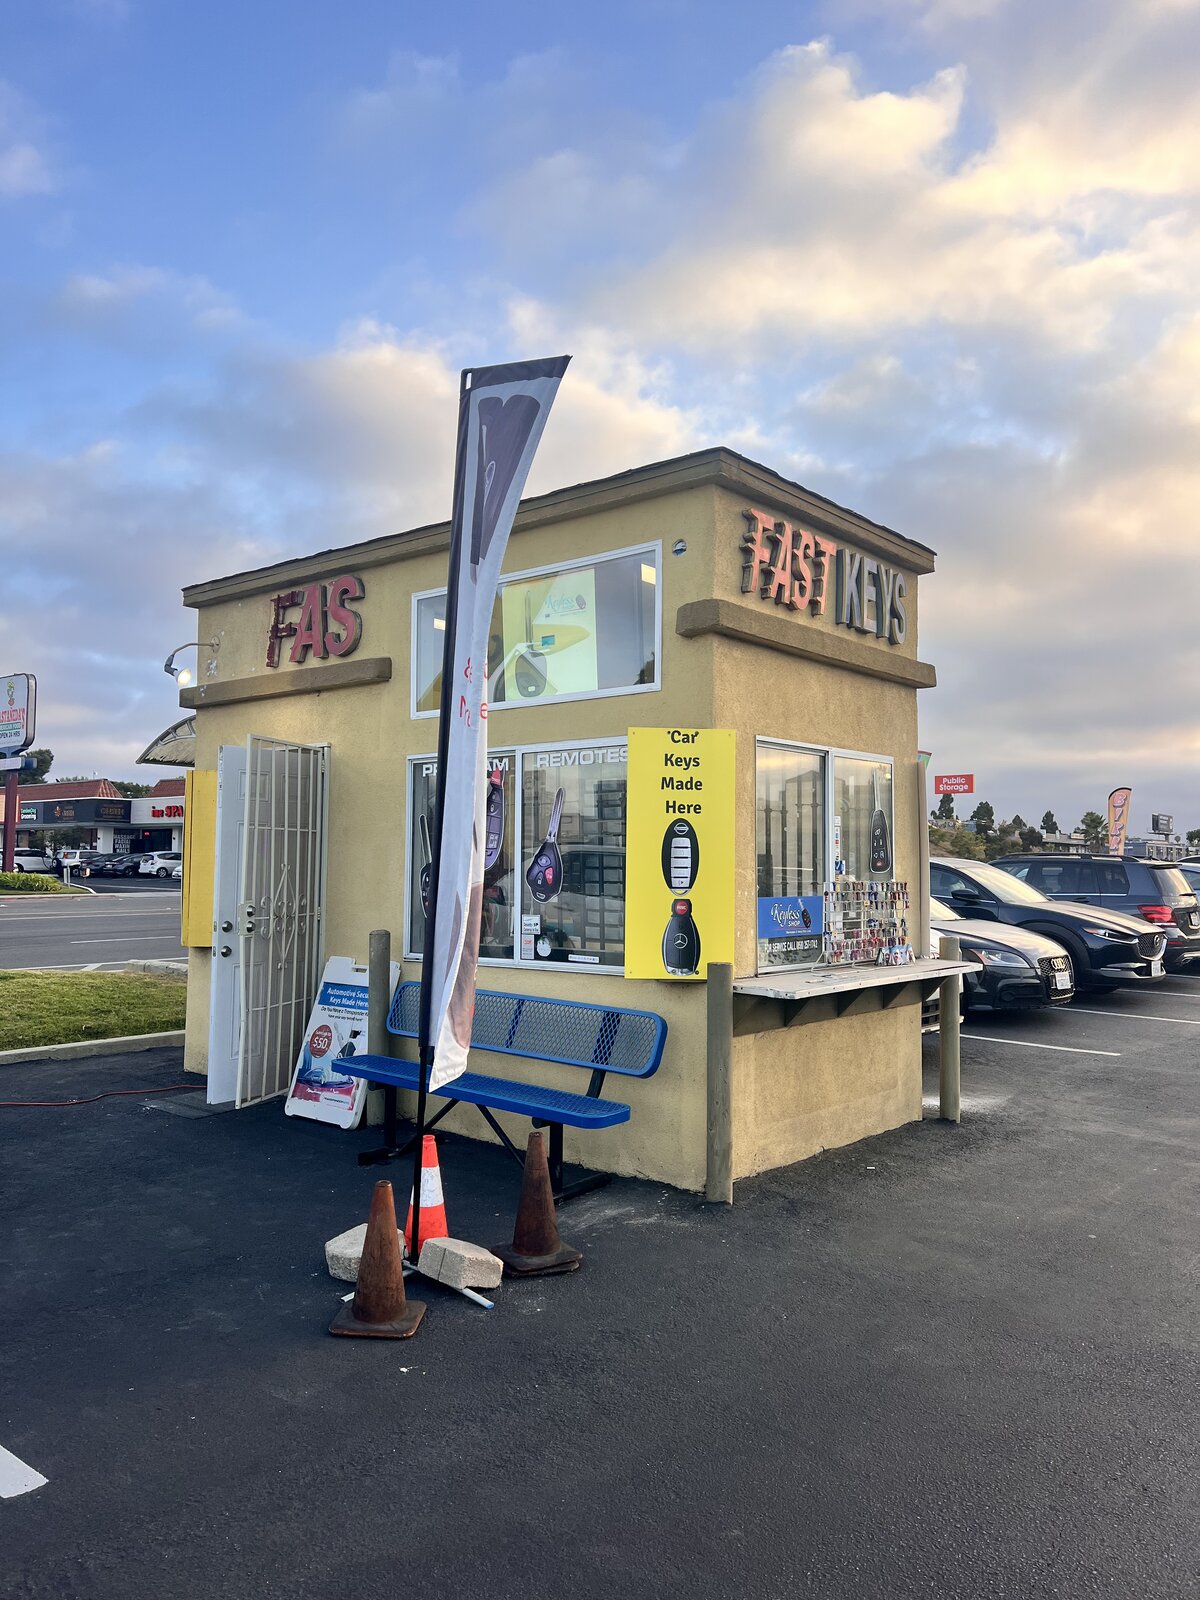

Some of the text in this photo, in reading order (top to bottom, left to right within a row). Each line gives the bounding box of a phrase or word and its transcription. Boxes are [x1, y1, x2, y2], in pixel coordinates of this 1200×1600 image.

[740, 507, 907, 646] FAST KEYS
[266, 575, 366, 668] FAS
[670, 730, 697, 743] Car
[537, 750, 628, 768] REMOTES
[664, 753, 700, 770] Keys
[661, 776, 702, 790] Made
[942, 777, 966, 785] Public
[164, 804, 183, 817] SPA
[665, 800, 702, 814] Here
[770, 902, 800, 928] Keyless
[773, 942, 787, 952] SERVICE
[787, 942, 797, 951] CALL
[327, 987, 369, 999] Automotive Secu
[329, 996, 341, 1005] Keys
[341, 998, 356, 1006] Made
[312, 1036, 328, 1050] $50
